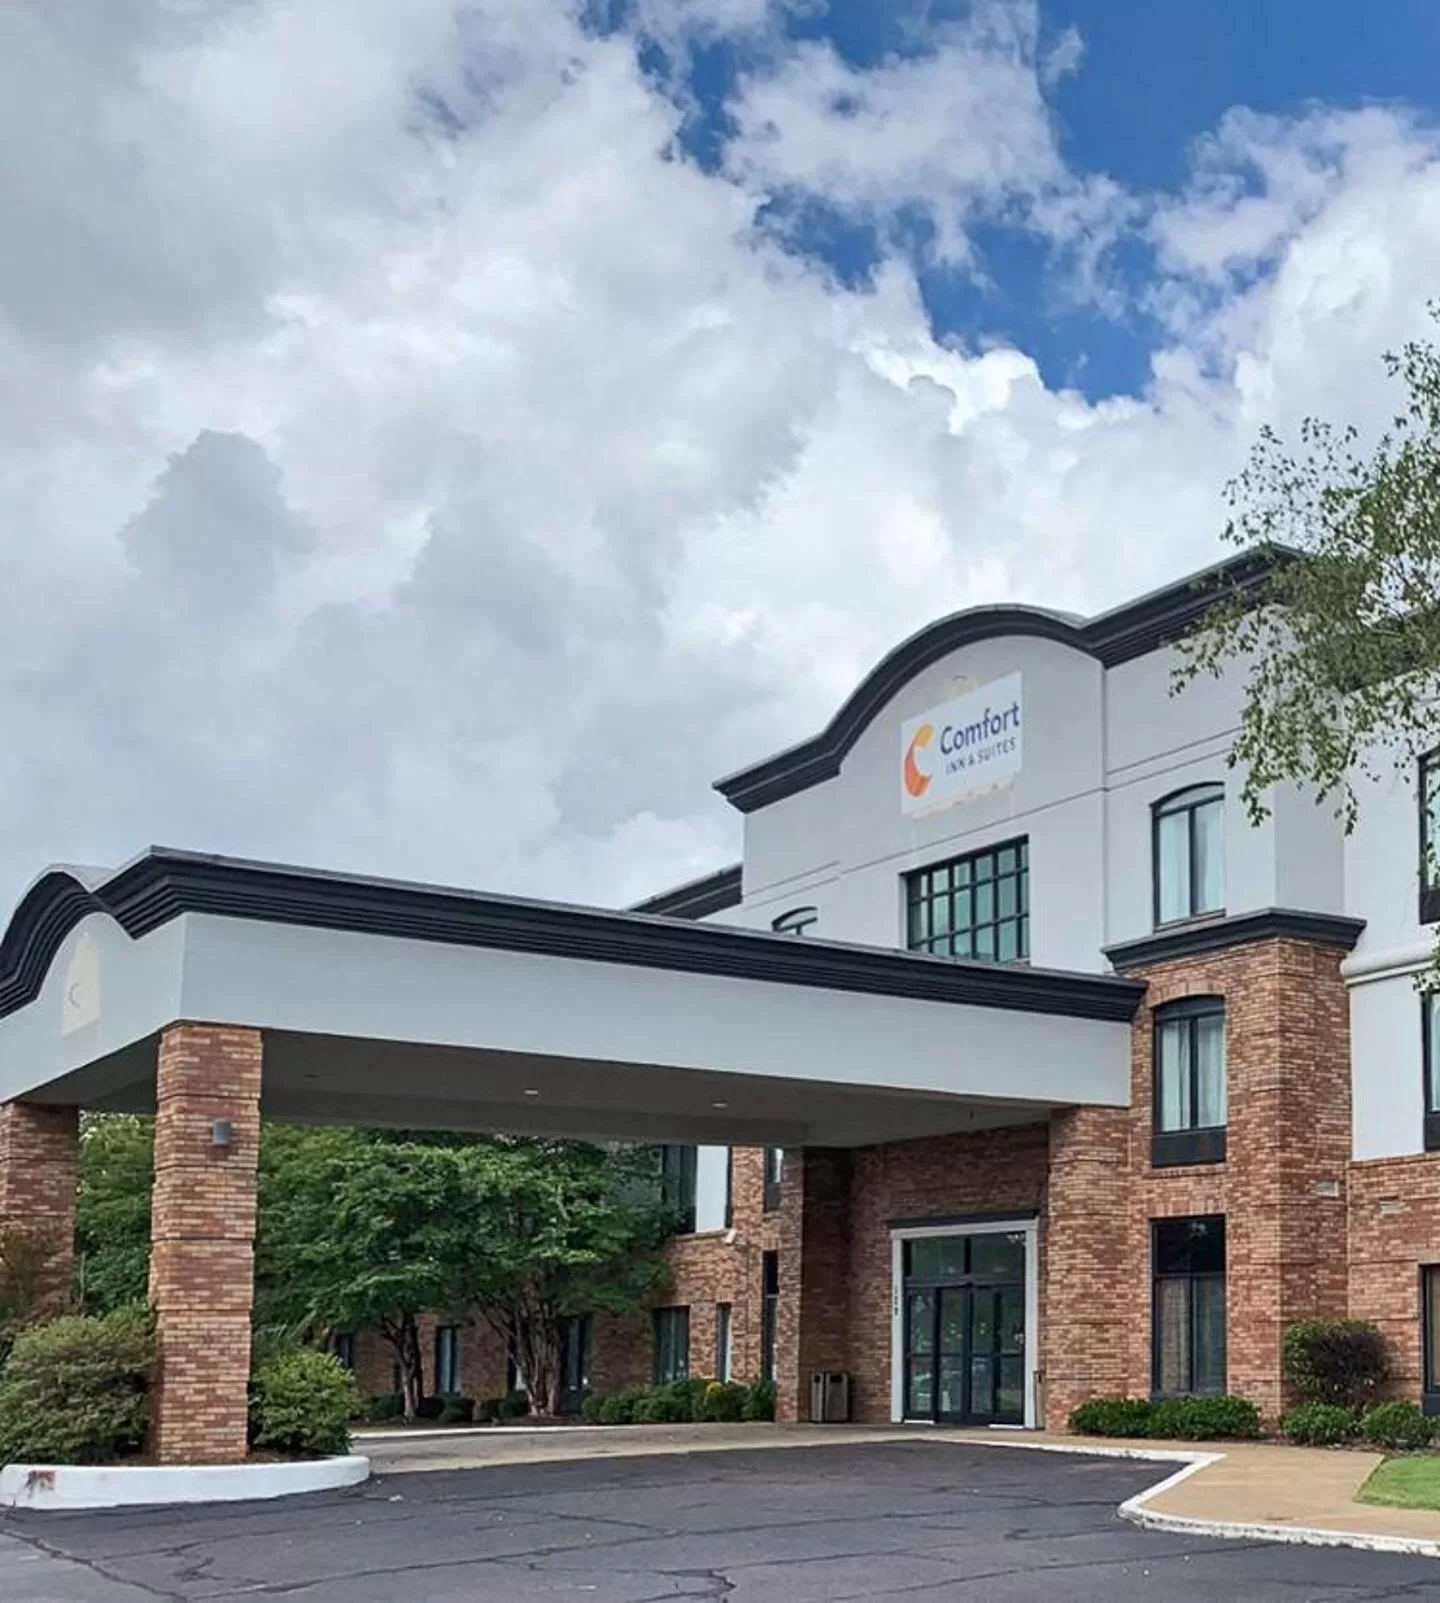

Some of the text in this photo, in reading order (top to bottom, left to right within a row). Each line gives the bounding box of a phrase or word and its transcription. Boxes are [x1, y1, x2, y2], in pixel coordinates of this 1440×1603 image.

[940, 702, 1019, 754] Comfort
[946, 758, 965, 775] INN
[978, 736, 1016, 764] SUITES
